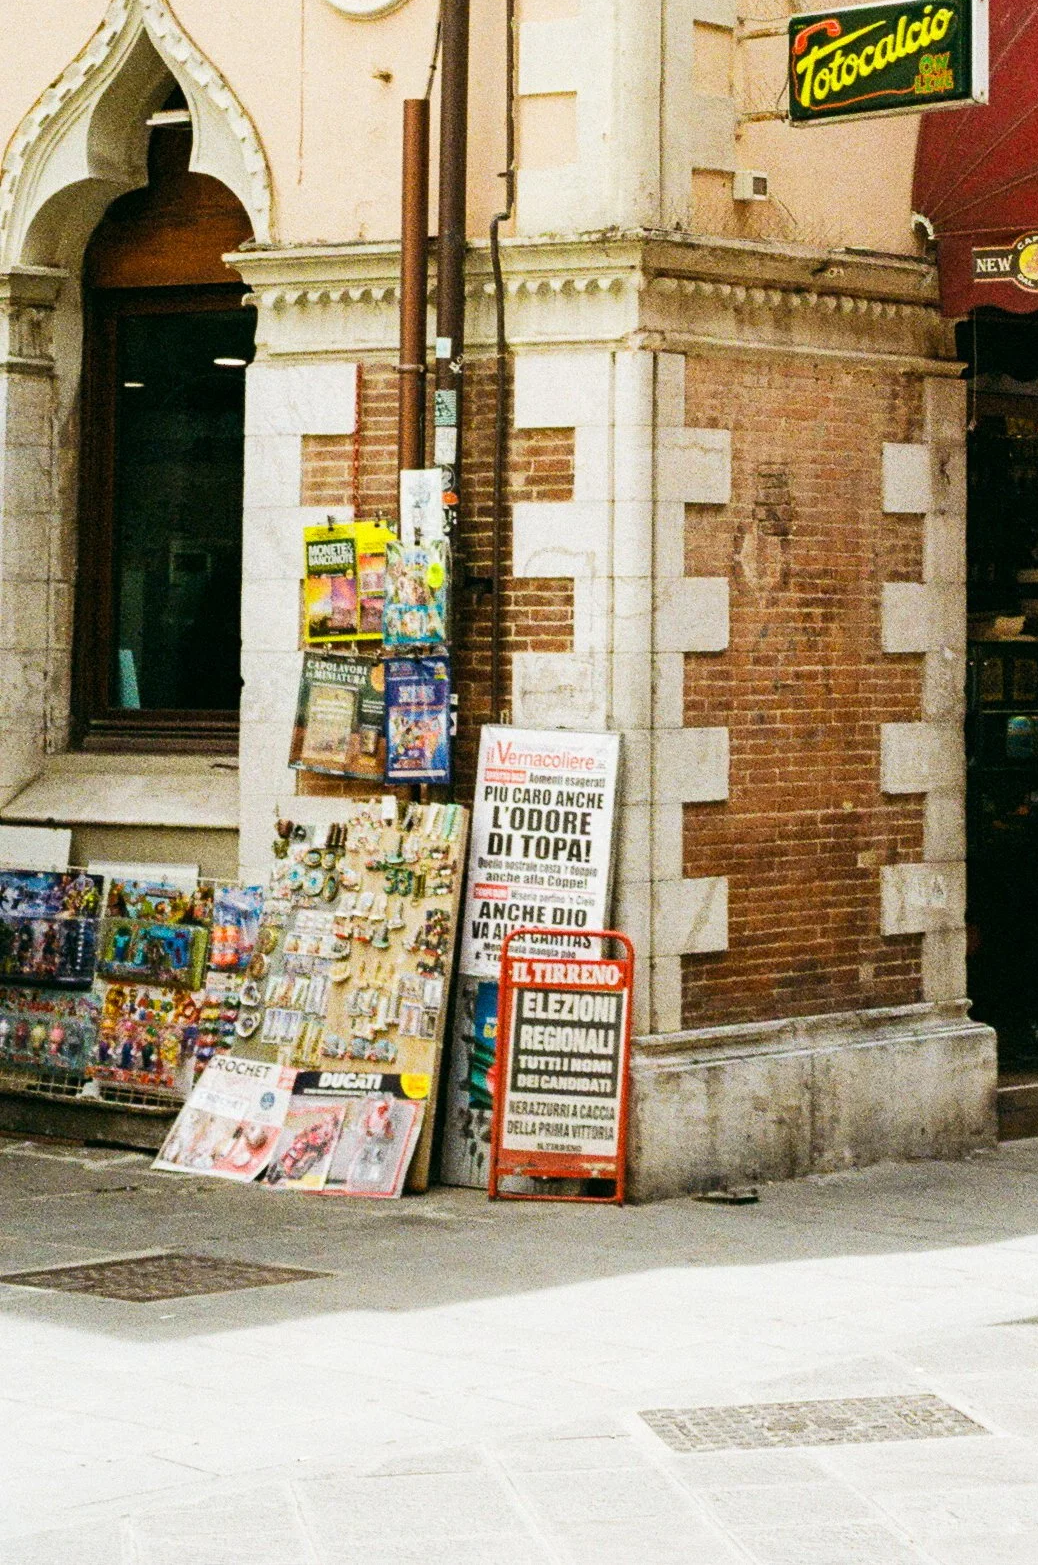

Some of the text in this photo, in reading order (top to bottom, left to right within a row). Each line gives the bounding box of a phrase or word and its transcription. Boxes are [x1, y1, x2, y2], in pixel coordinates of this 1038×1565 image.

[796, 5, 954, 107] Totocalcio
[919, 51, 951, 75] ON
[914, 70, 954, 94] LINE
[976, 254, 1013, 273] NEW
[306, 660, 368, 675] CAPOLAVORI
[496, 740, 595, 770] Vernacoliere
[512, 787, 551, 806] CARO
[555, 790, 605, 810] ANCHE
[492, 806, 592, 835] L'ODORE
[487, 832, 592, 863] DI TOPA!
[486, 871, 520, 883] anche
[479, 901, 588, 928] ANCHE DIO
[472, 920, 489, 939] VA
[511, 961, 620, 986] IL TIRRENO
[522, 991, 617, 1024] ELEZIONI
[519, 1024, 615, 1055] REGIONALI
[518, 1055, 561, 1071] TUTTI
[570, 1057, 613, 1074] NOMI
[318, 1071, 383, 1090] DUCATI
[517, 1073, 612, 1093] DEI CANDIDATI
[509, 1100, 570, 1118] NERAZZURRI
[579, 1104, 615, 1120] CACCIA
[507, 1120, 614, 1141] DELLA PRIMA VITTORIA
